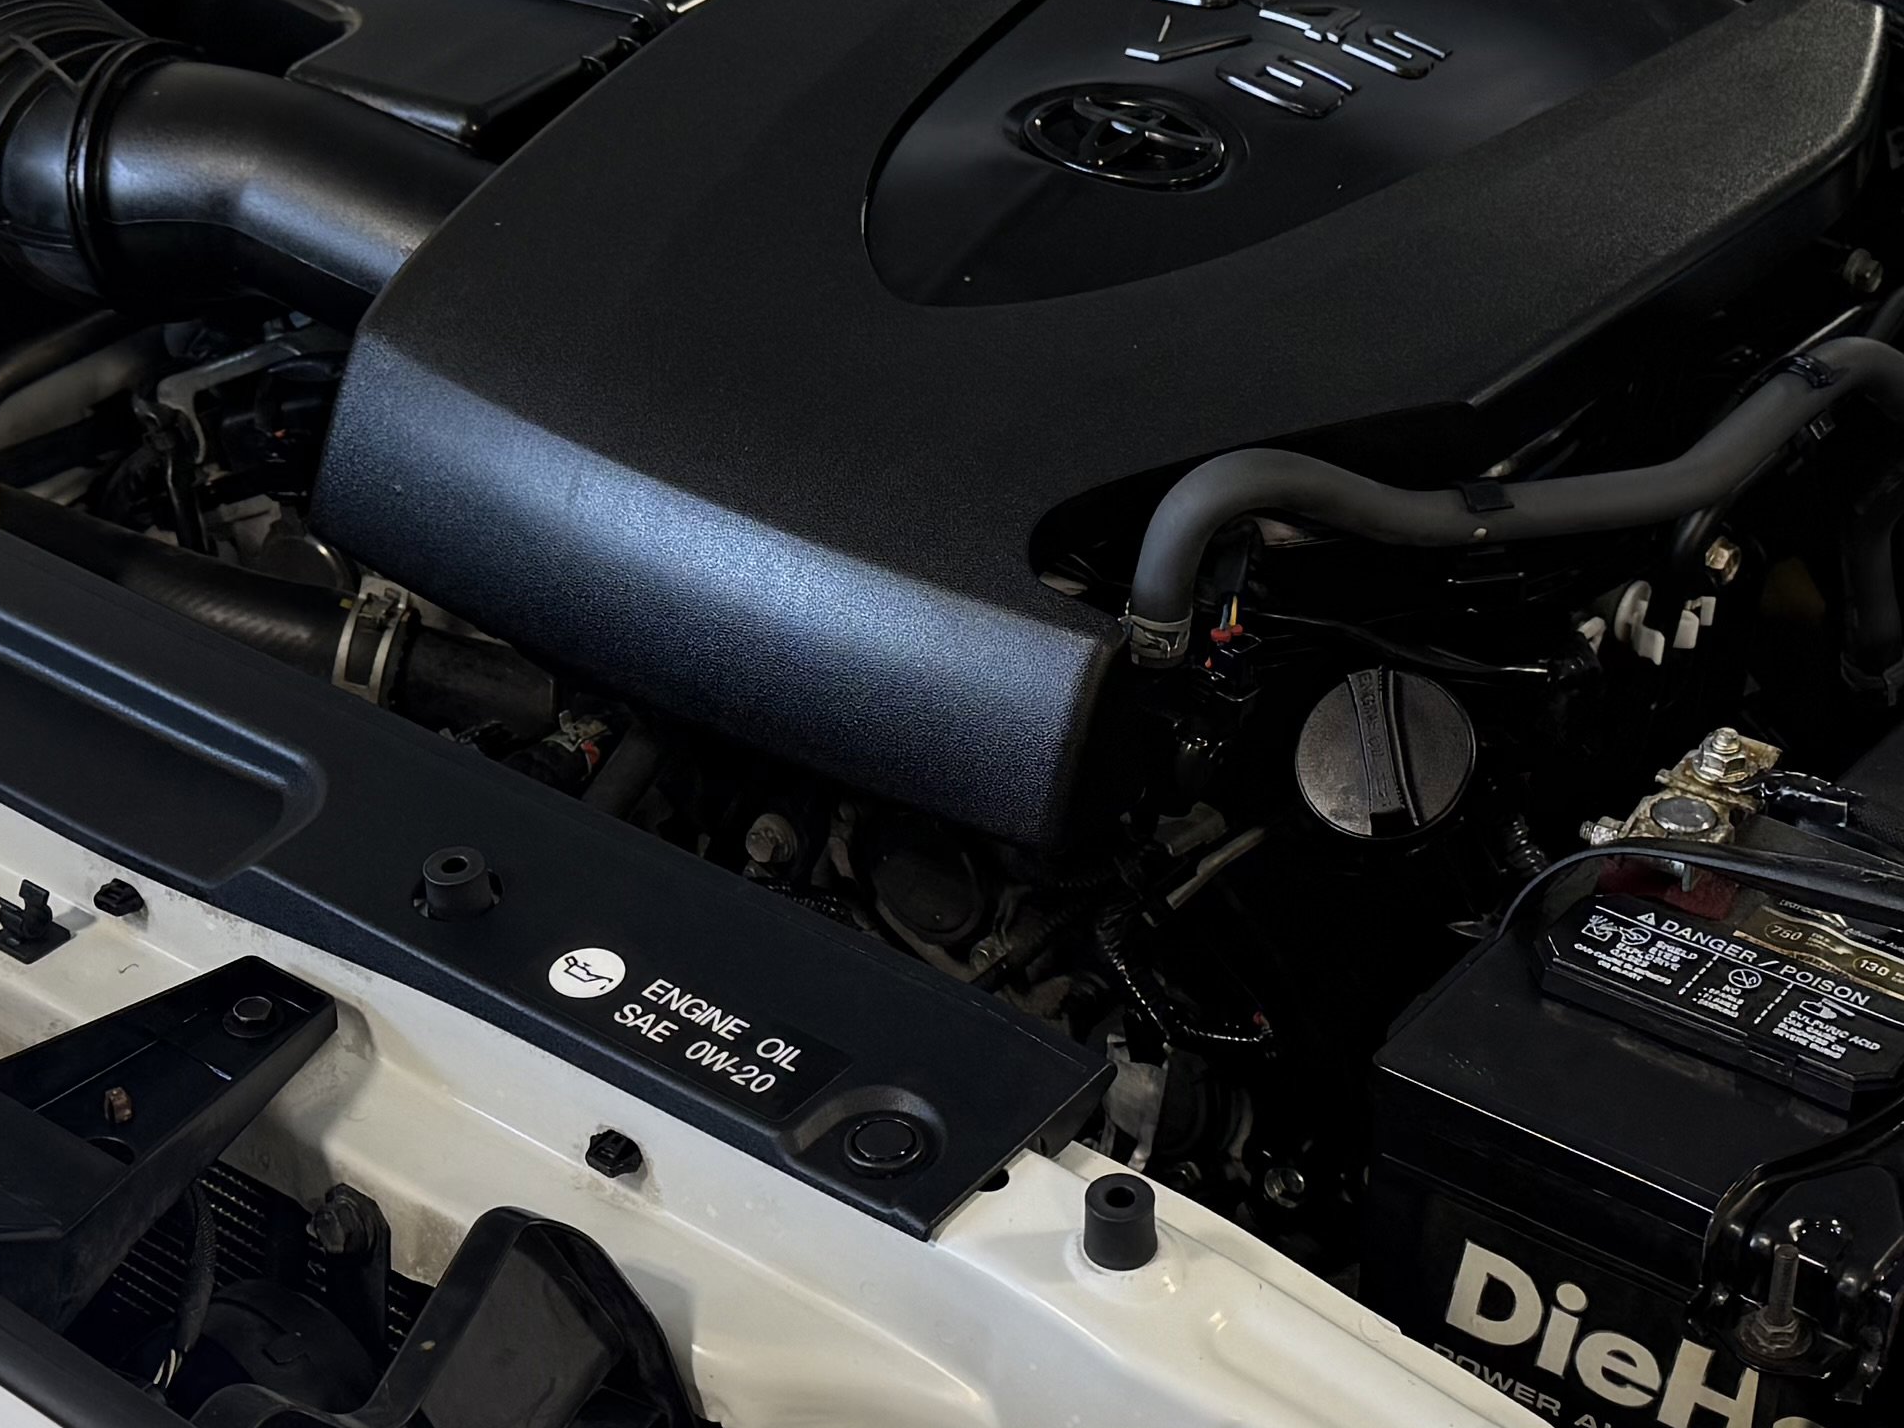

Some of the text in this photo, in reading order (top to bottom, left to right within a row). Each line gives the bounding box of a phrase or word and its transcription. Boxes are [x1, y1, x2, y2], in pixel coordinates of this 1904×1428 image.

[1124, 11, 1360, 119] V6
[1659, 919, 1758, 964] DANGER
[1780, 965, 1870, 1006] POISON
[1722, 984, 1742, 995] NO
[1859, 959, 1890, 977] 130
[613, 1003, 777, 1094] SAE 0W-20
[640, 977, 802, 1073] ENGINE OIL
[1787, 1010, 1882, 1051] SULFURIC ACID
